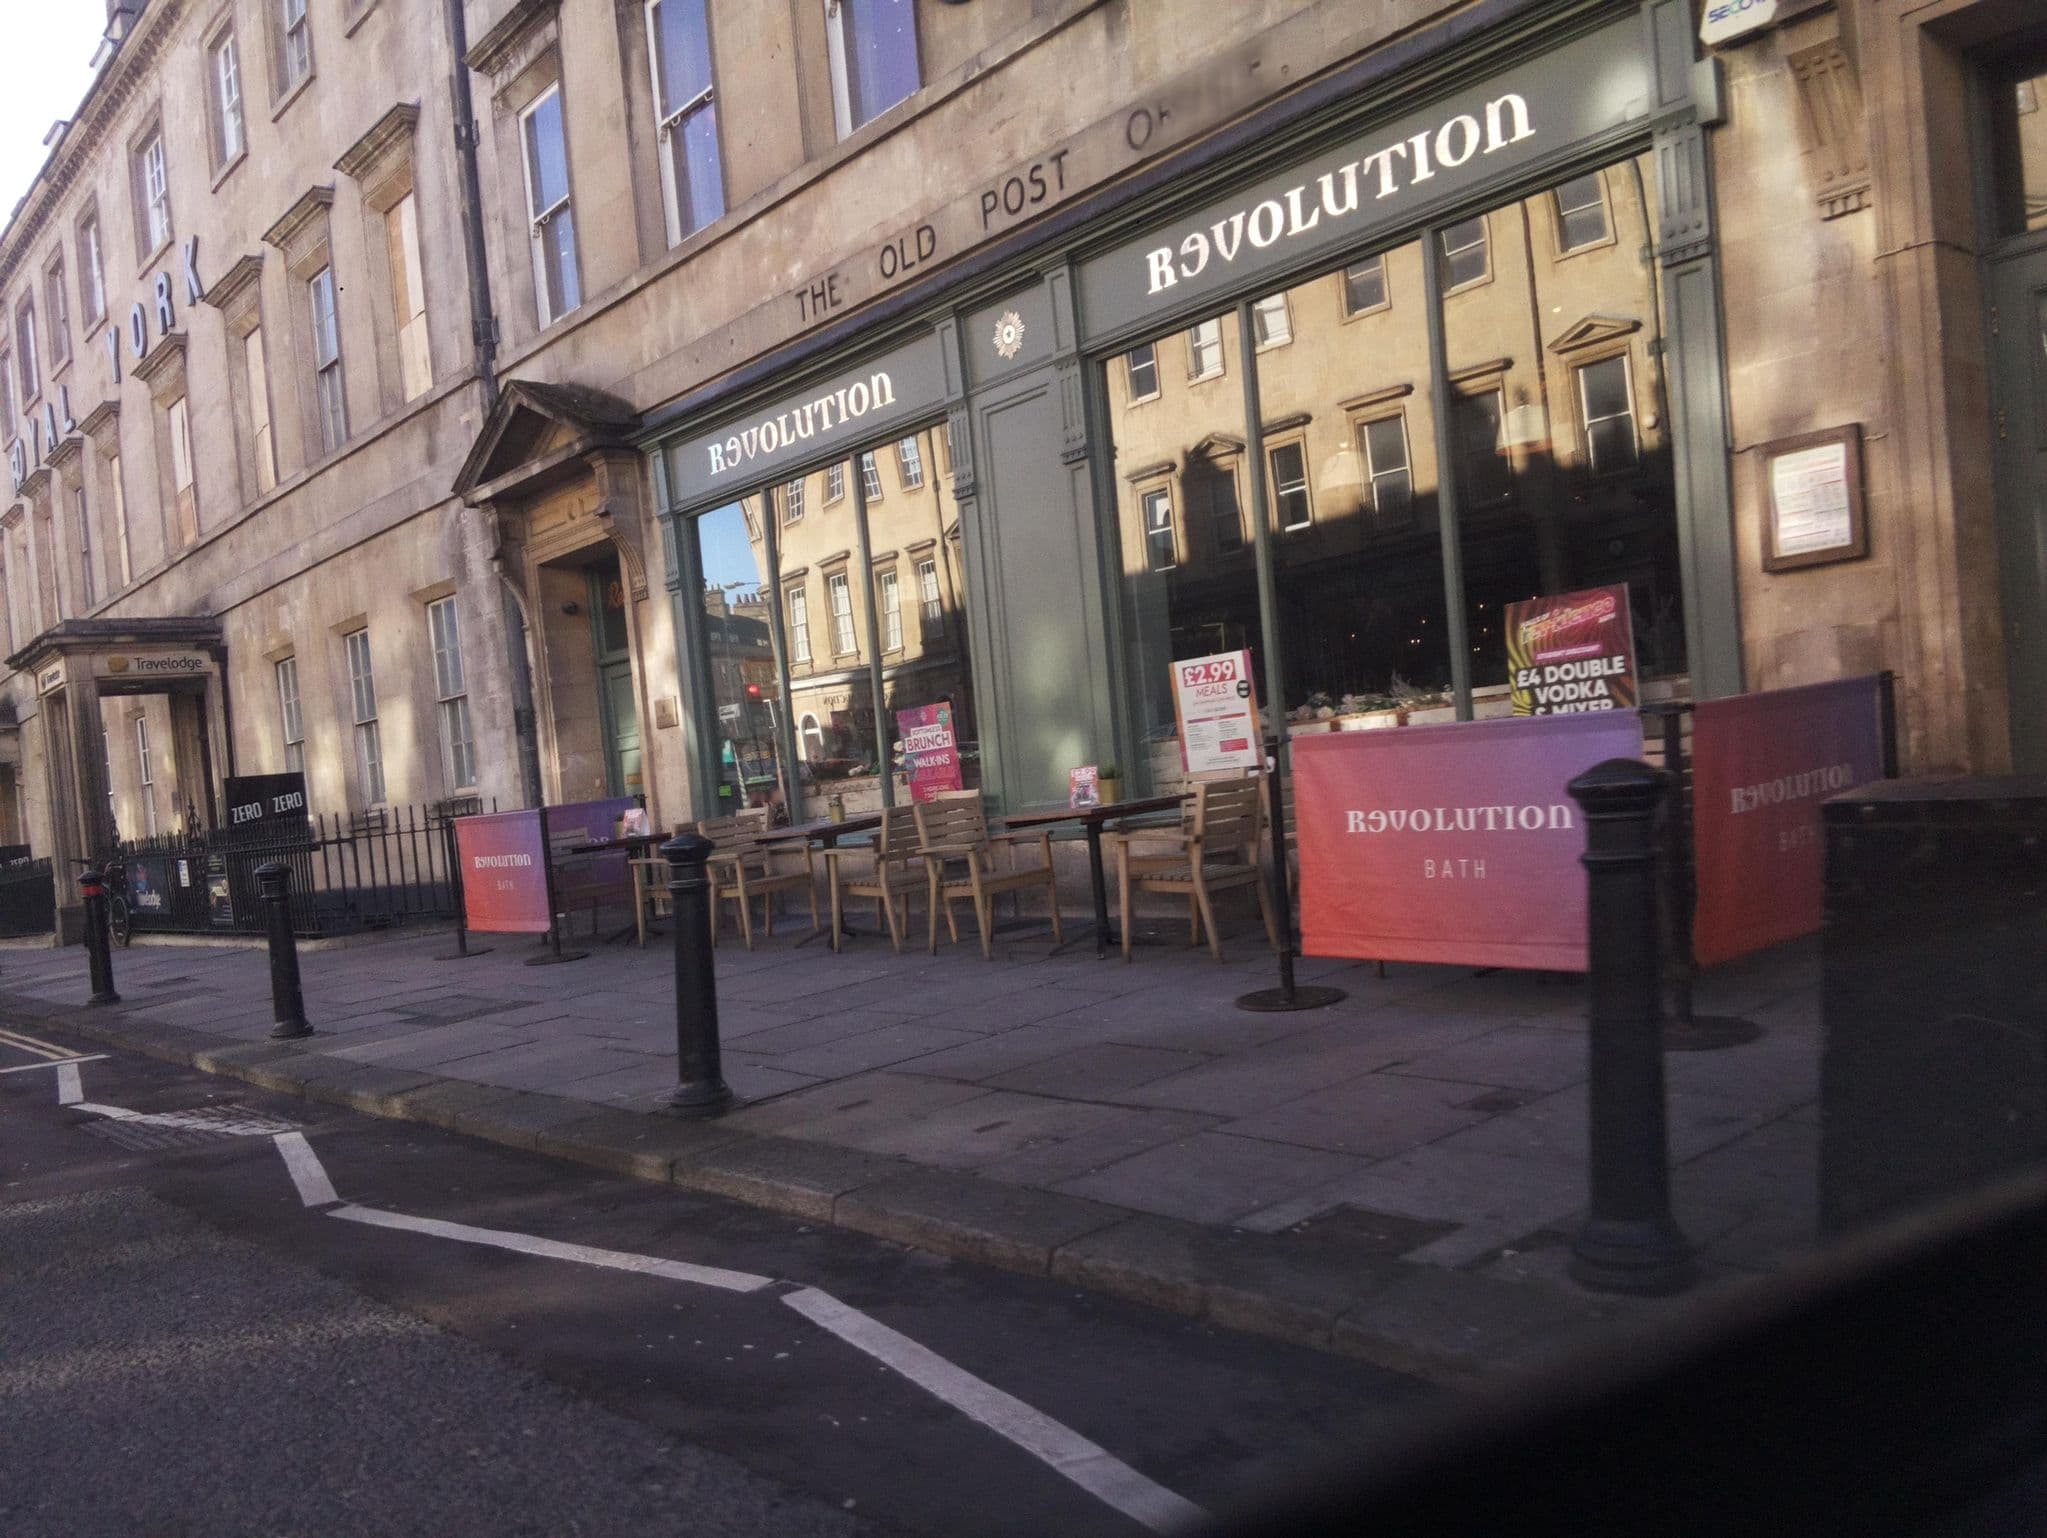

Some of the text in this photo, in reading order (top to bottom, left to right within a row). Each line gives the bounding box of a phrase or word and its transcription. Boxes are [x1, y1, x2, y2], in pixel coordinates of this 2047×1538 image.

[795, 149, 1069, 323] THE OLD POST
[106, 234, 205, 384] YORK
[134, 656, 202, 670] Travelodge
[1184, 661, 1234, 686] £2.99
[1517, 655, 1626, 688] £4 DOUBLE
[1195, 683, 1228, 697] MEALS
[1535, 679, 1610, 705] VODKA
[906, 732, 951, 751] BRUNCH
[231, 791, 304, 824] ZERO ZERO
[1424, 858, 1487, 880] BATH
